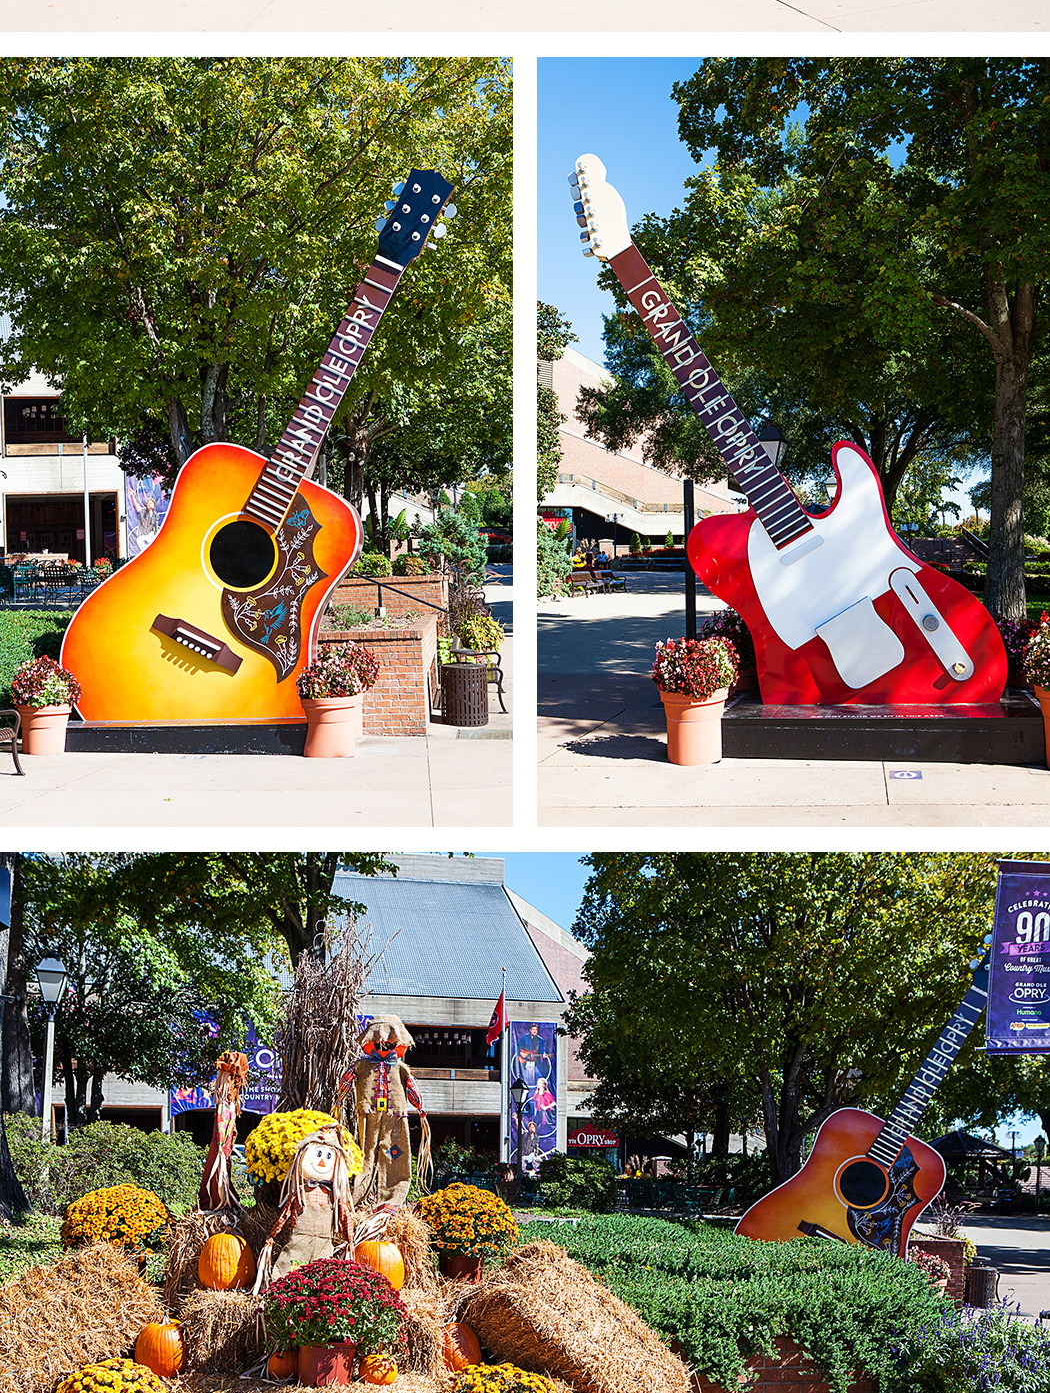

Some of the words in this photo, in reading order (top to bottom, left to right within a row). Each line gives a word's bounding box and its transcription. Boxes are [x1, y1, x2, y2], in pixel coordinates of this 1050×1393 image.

[339, 294, 374, 353] OPRY
[641, 290, 694, 366] GRAND
[316, 356, 349, 402] OLE
[688, 368, 726, 416] OLE
[276, 405, 324, 482] GRAND
[717, 416, 764, 474] OPRY
[1008, 900, 1050, 913] CELEBRAT
[1016, 911, 1050, 944] 90
[1004, 963, 1033, 974] Country
[1034, 964, 1050, 974] Mus
[1018, 944, 1045, 953] YEARS
[1014, 988, 1046, 998] OPRY
[940, 1012, 966, 1053] OPRY
[922, 1053, 946, 1084] OLE
[890, 1086, 926, 1138] GRAND
[577, 1133, 605, 1146] OPRY
